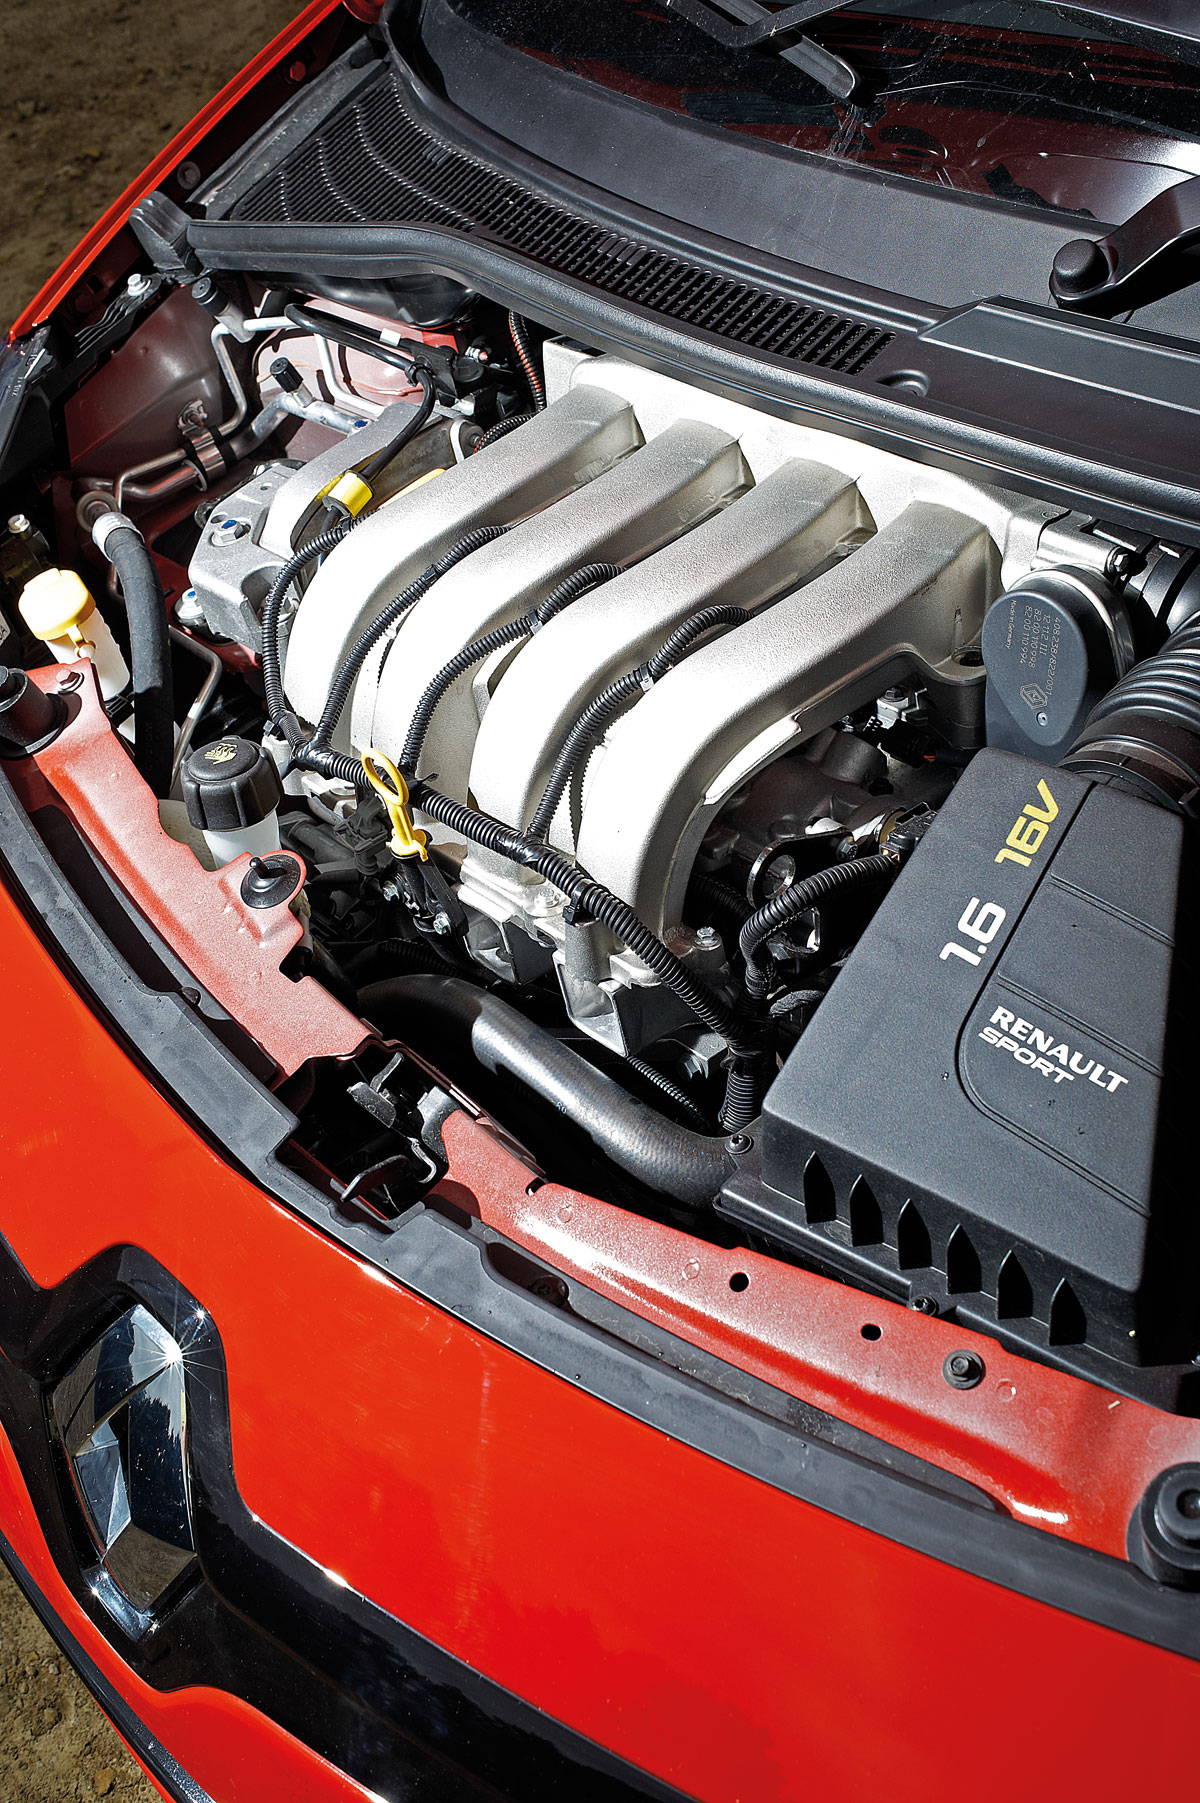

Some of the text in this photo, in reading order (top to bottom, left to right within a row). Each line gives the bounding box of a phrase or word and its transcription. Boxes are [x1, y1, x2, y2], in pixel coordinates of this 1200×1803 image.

[1005, 623, 1014, 649] Germany
[1022, 632, 1030, 646] 110
[1030, 635, 1038, 649] 110
[1020, 647, 1028, 664] 994
[1028, 650, 1037, 668] 998
[939, 778, 1059, 966] 1.6 16V
[978, 1026, 1075, 1084] SPORT
[990, 1006, 1128, 1093] RENAULT
